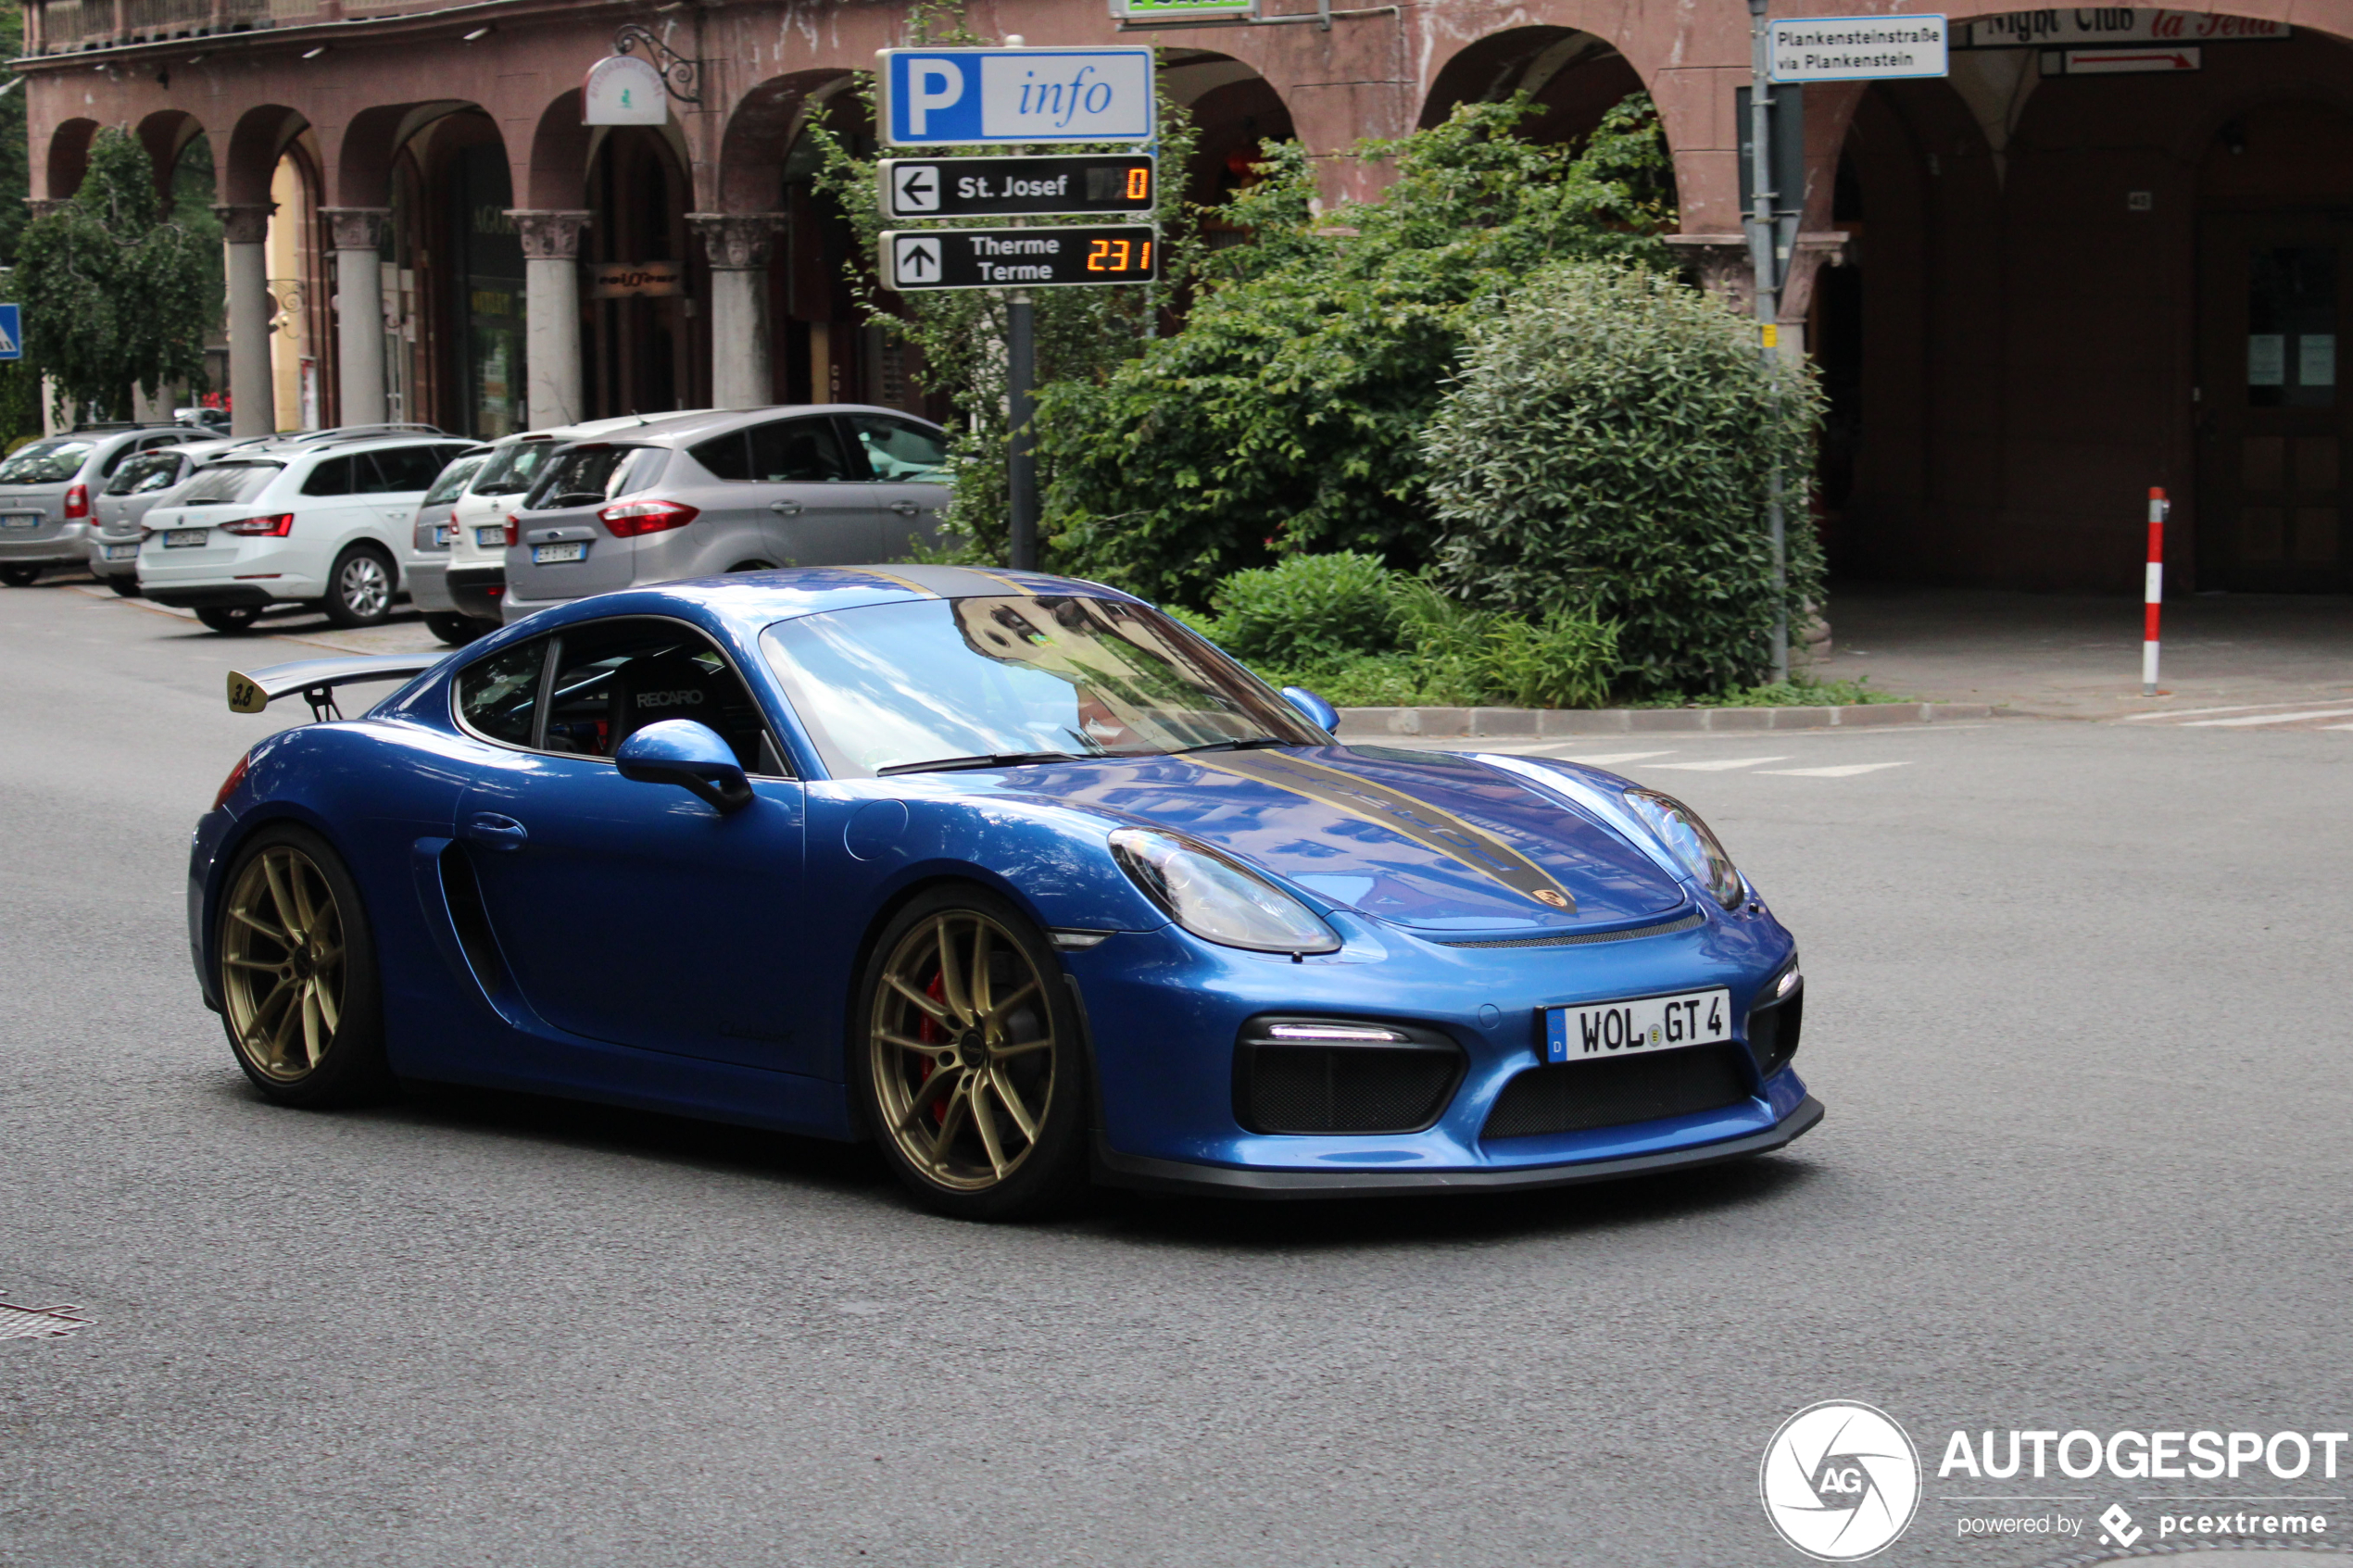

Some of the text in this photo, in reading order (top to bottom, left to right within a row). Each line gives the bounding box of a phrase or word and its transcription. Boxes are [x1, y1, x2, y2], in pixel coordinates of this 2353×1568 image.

[1778, 28, 1940, 46] Plankensteinstraße
[1778, 53, 1913, 69] via Plankenstein
[908, 58, 1112, 135] P info
[957, 169, 1148, 199] St. Josef 0
[969, 237, 1060, 256] Therme
[1087, 239, 1151, 271] 231
[977, 262, 1052, 281] Terme
[233, 684, 254, 707] 3.8
[636, 689, 704, 709] RECARO
[1580, 996, 1722, 1053] WOL GT 4
[1554, 1041, 1562, 1053] D
